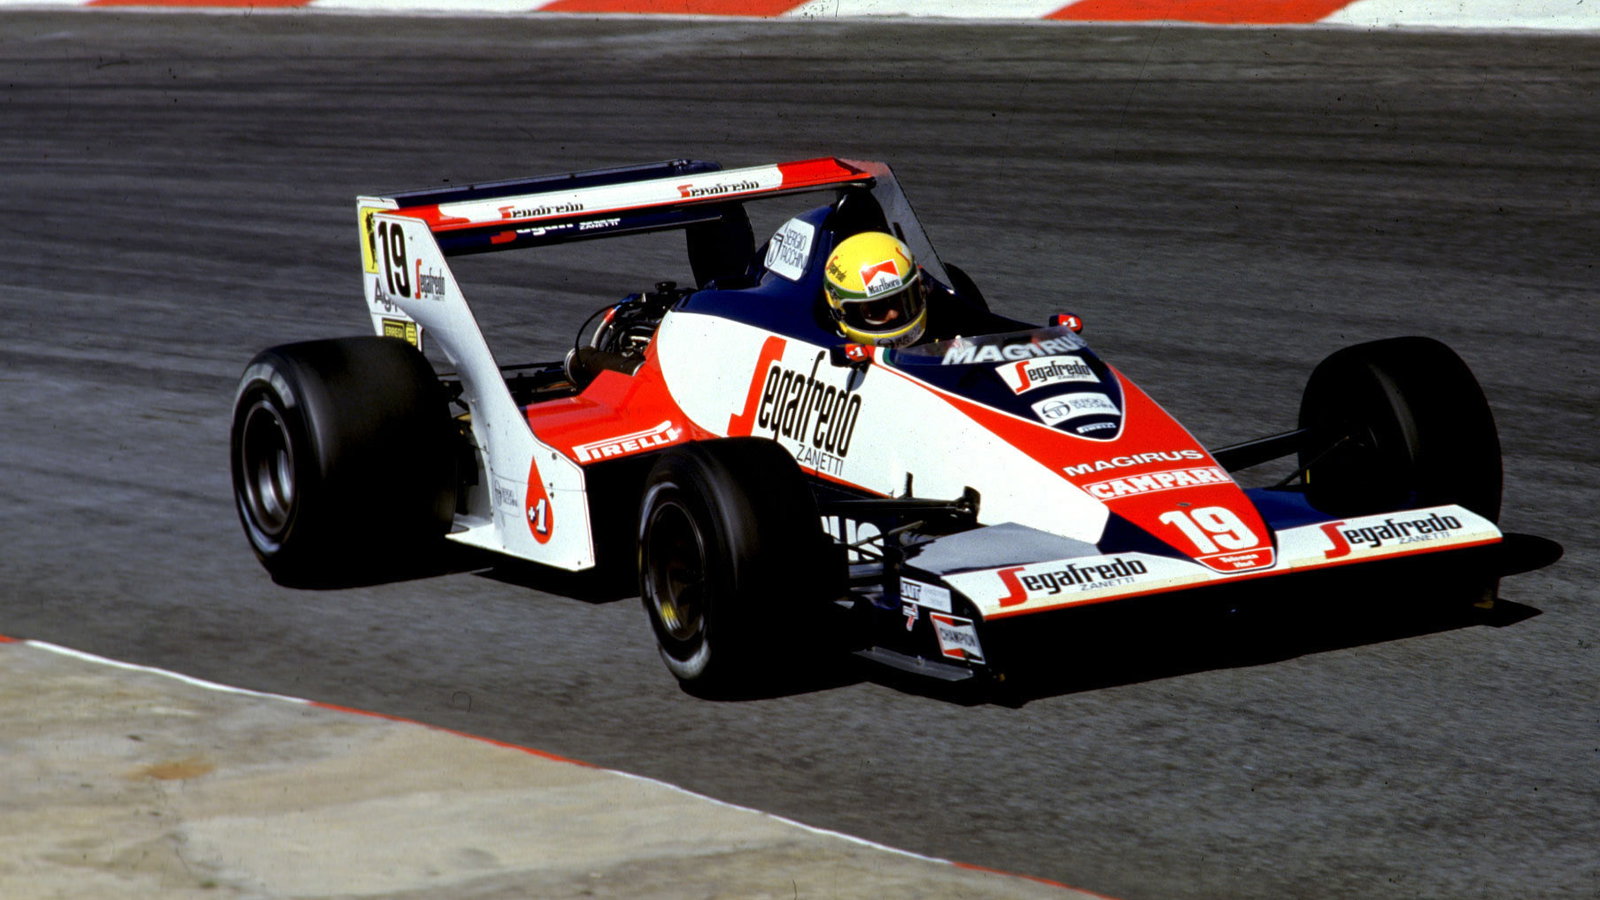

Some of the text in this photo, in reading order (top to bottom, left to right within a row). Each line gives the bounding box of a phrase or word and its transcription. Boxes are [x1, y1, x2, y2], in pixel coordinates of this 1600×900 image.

[378, 221, 411, 298] 19
[867, 278, 901, 295] Marlboro
[941, 332, 1089, 366] MAGIRUS
[1014, 360, 1092, 394] Segafredo
[727, 335, 862, 458] Segafredo
[796, 443, 844, 477] ZANETTI
[1062, 449, 1205, 477] MAGIRUS
[1089, 467, 1231, 498] CAMPARI
[1158, 506, 1260, 554] 19
[1319, 512, 1463, 560] Segafredo
[997, 557, 1148, 608] Segafredo
